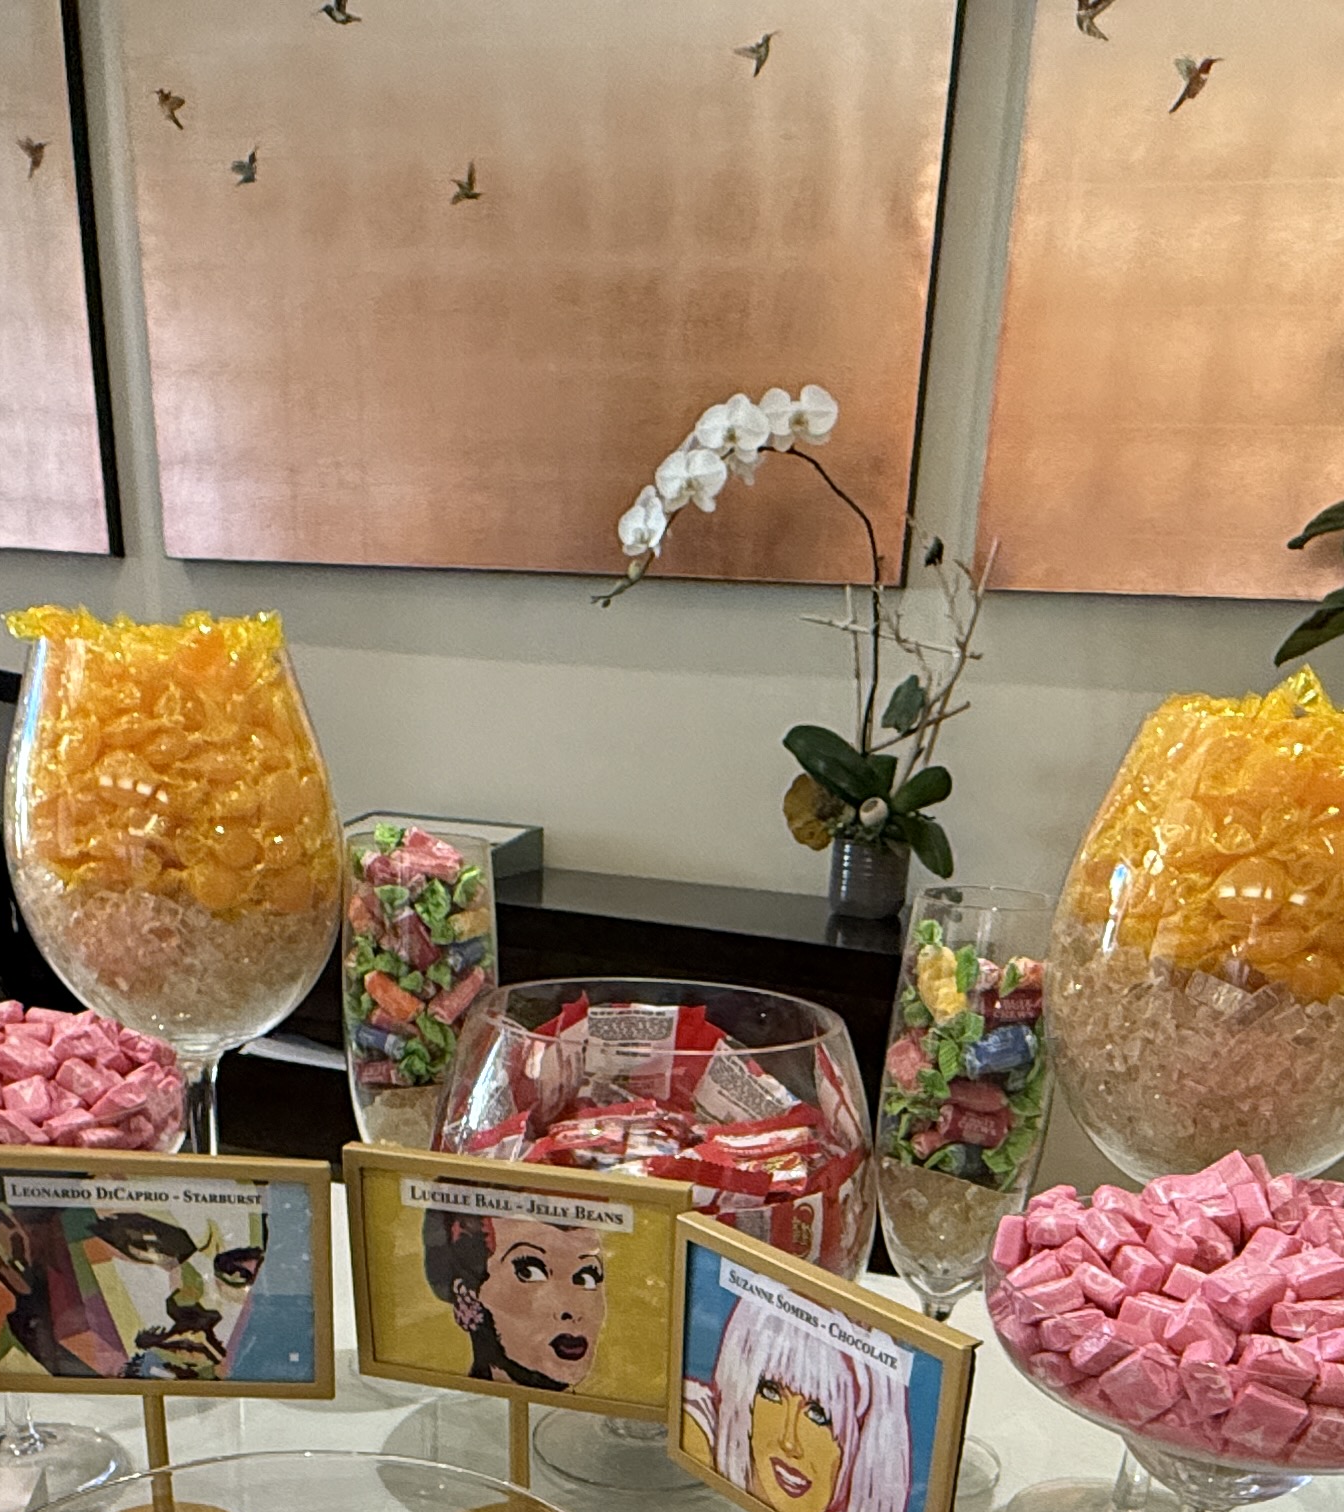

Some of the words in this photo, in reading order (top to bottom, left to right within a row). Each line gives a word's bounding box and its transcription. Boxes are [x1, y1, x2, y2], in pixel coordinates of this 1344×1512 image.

[11, 1183, 92, 1201] LEONARDO
[183, 1189, 262, 1205] STARBURST
[410, 1185, 471, 1207] LUCILLE
[475, 1194, 512, 1212] BALL
[526, 1200, 570, 1218] JELLY
[575, 1206, 624, 1225] BEANS
[729, 1270, 775, 1305] SUZANNE
[776, 1294, 819, 1328] SOMERS
[828, 1322, 898, 1370] CHOCOLATE
